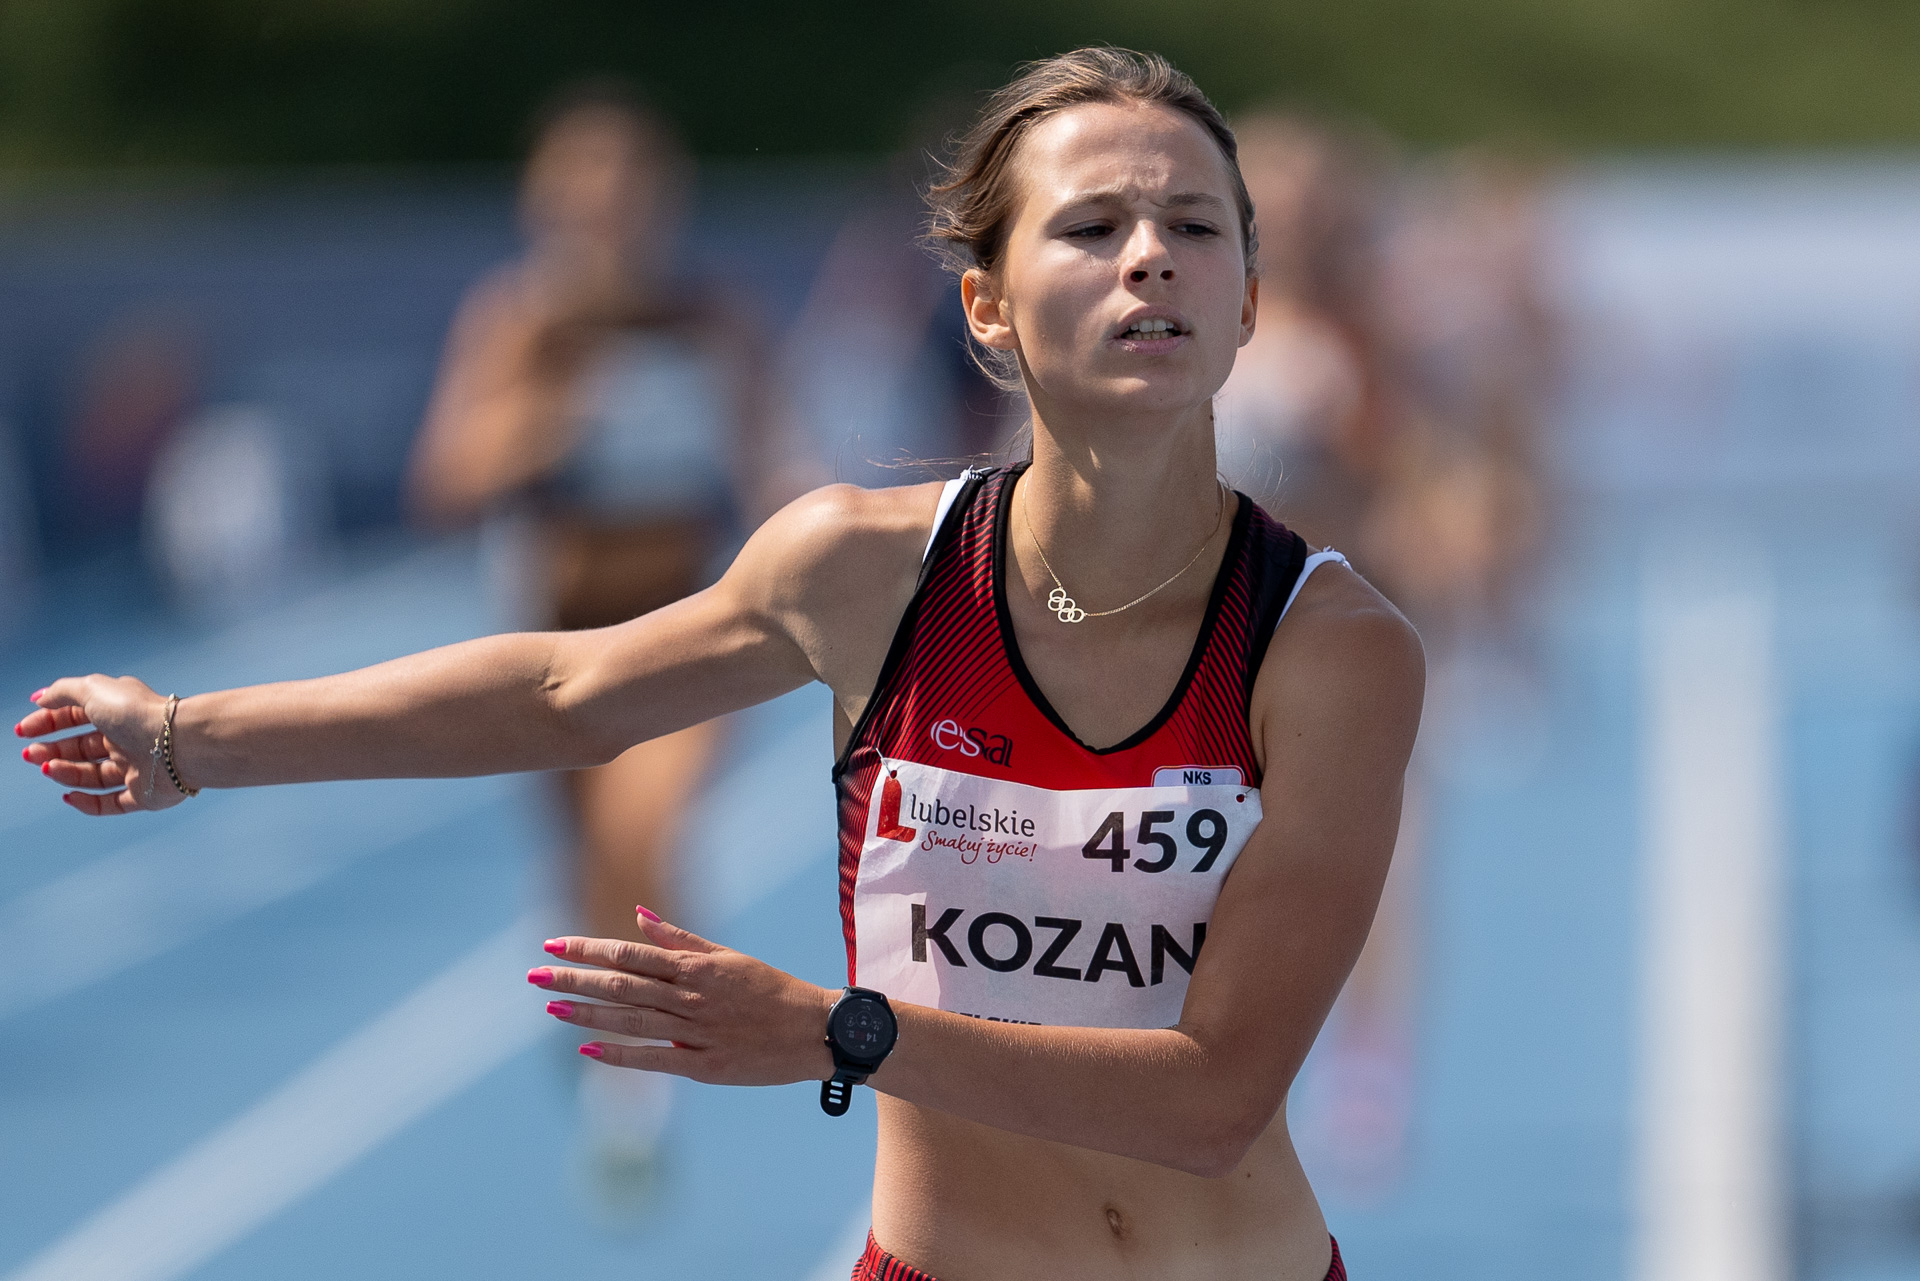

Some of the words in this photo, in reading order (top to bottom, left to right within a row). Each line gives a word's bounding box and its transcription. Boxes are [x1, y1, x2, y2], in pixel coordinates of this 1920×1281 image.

[1183, 771, 1212, 785] NKS
[921, 830, 984, 864] Smakuj
[986, 838, 1038, 864] życie!
[1081, 808, 1228, 873] 459
[911, 903, 1207, 988] KOZAN
